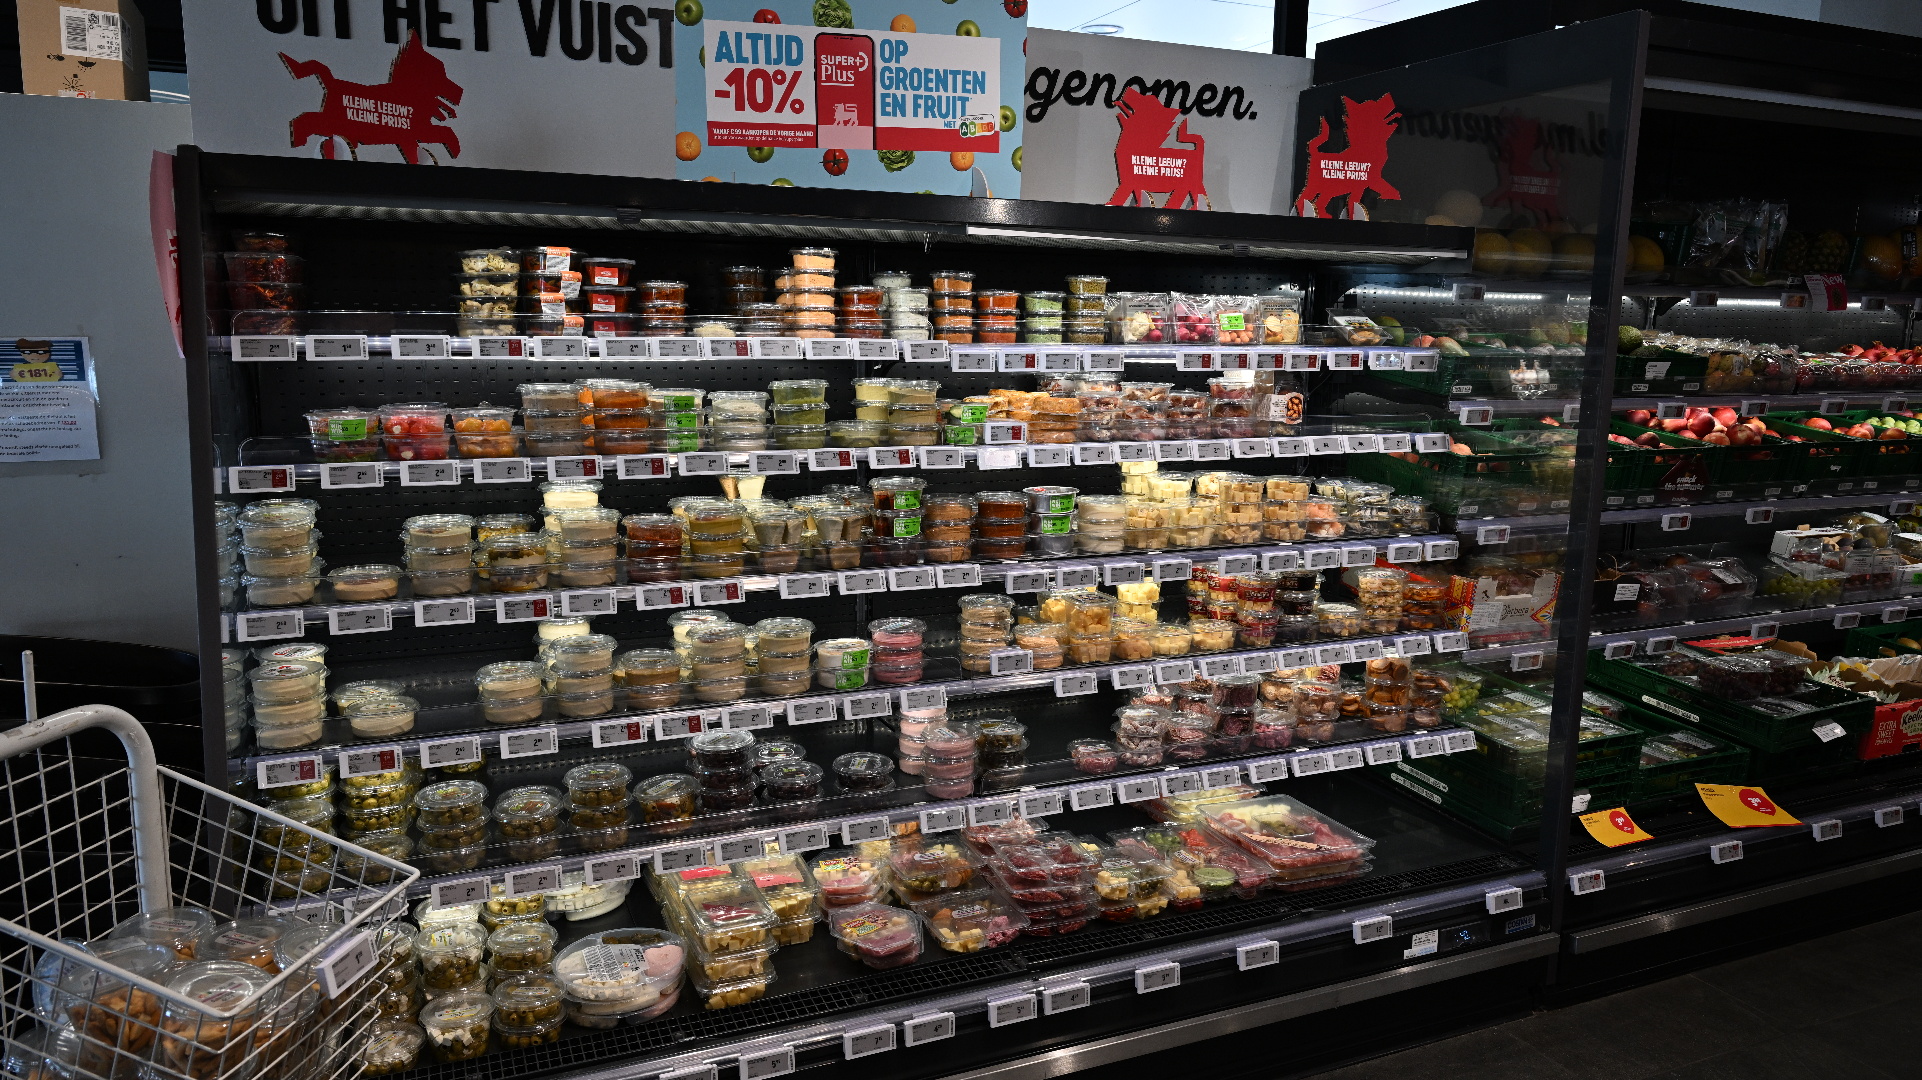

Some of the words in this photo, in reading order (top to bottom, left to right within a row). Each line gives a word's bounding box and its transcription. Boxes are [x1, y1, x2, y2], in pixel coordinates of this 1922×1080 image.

[383, 0, 499, 52] HET
[519, 0, 675, 69] VUIST
[715, 30, 804, 67] ALTIJD
[880, 38, 909, 64] OP
[820, 64, 855, 82] Plus
[880, 66, 987, 96] GROENTEN
[714, 67, 806, 115] -10%
[1023, 66, 1258, 123] genomen.
[342, 94, 376, 112] KLEINE
[377, 100, 414, 118] LEEUW?
[880, 92, 910, 118] EN
[346, 107, 380, 125] KLEINE
[381, 113, 411, 130] PRIJS!
[943, 120, 957, 129] NET
[1131, 154, 1157, 166] KLEINE
[1158, 156, 1187, 169] LEEUW?
[1133, 165, 1159, 176] KLEINE
[1160, 166, 1184, 178] PRIJS!
[1320, 159, 1344, 170] KLEINE
[1344, 161, 1372, 172] LEEUW?
[1322, 169, 1346, 180] KLEINE
[1346, 170, 1368, 181] PRIJS!
[18, 369, 26, 378] €
[26, 368, 56, 379] 181,-
[1877, 729, 1897, 740] SWEET
[1879, 720, 1897, 731] EXTRA
